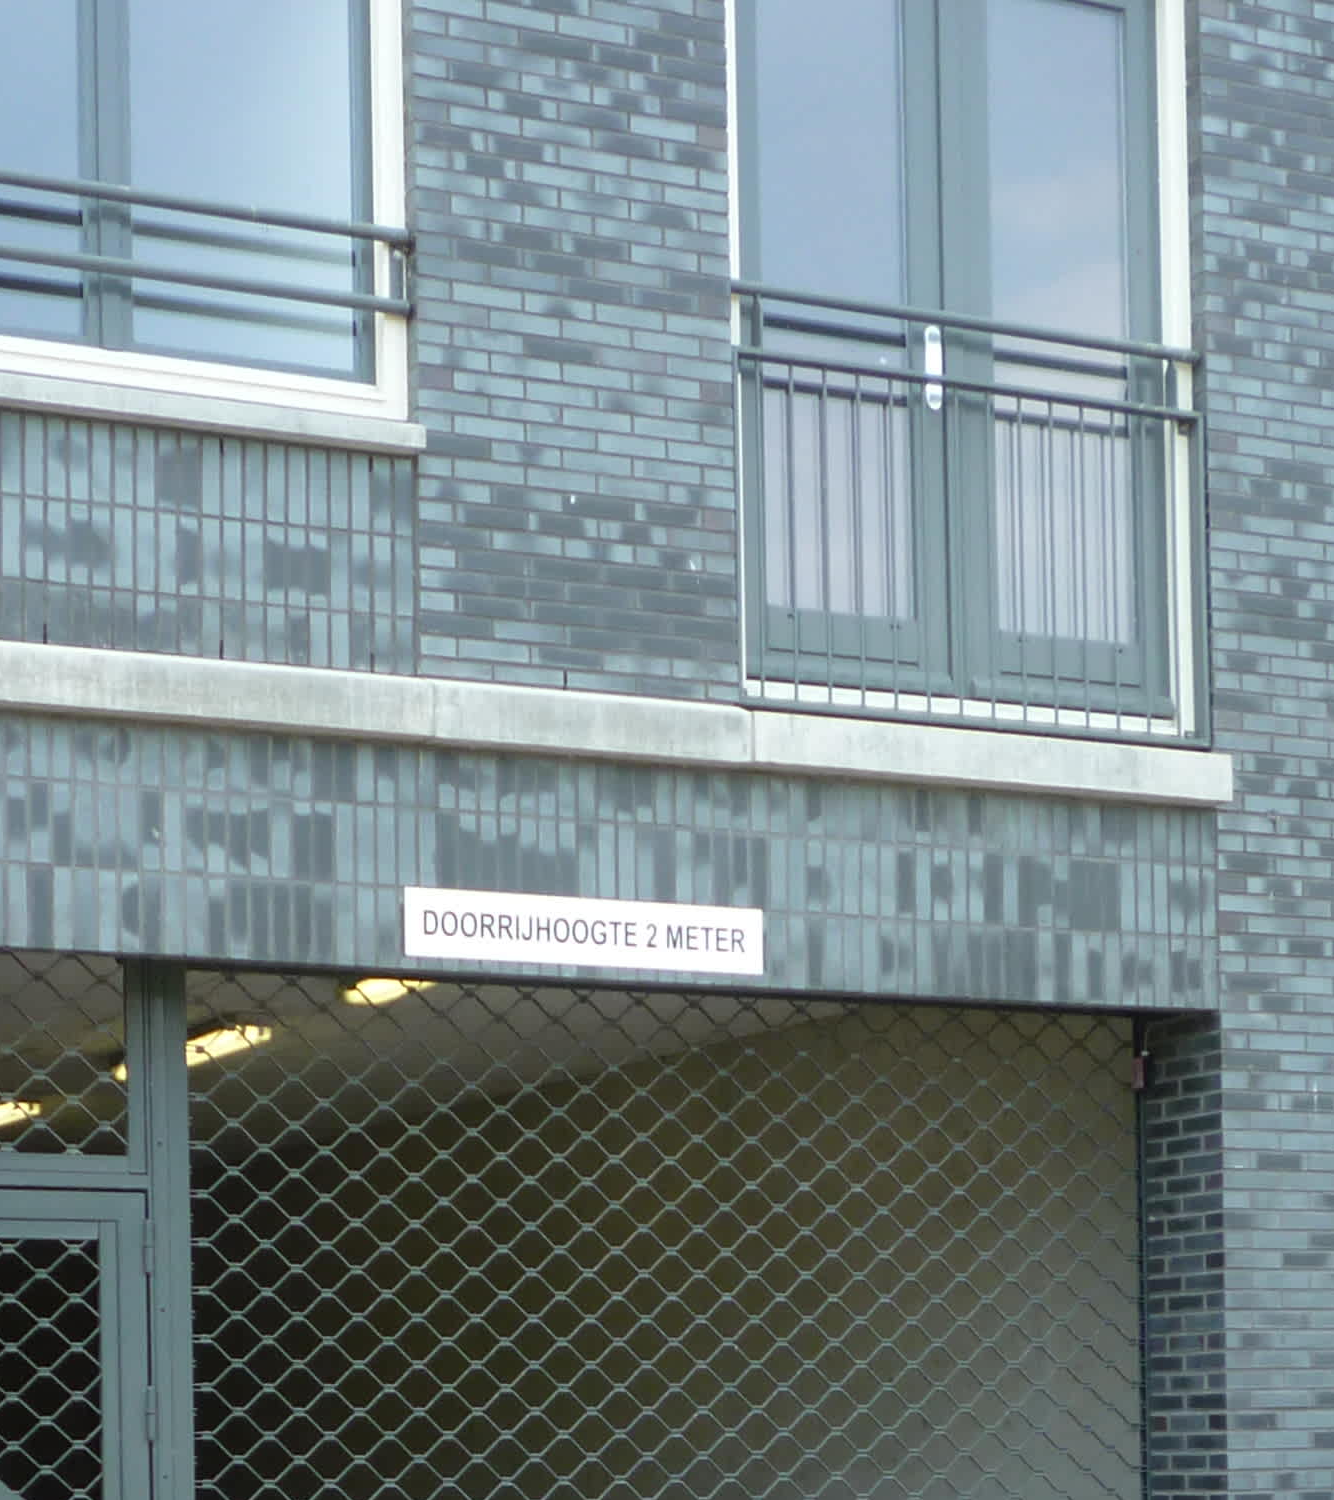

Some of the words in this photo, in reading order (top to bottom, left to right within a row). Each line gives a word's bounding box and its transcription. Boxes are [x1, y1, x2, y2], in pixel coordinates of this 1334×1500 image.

[423, 909, 637, 948] DOORRIJHOOGTE
[646, 924, 658, 949] 2
[666, 925, 746, 953] METER
